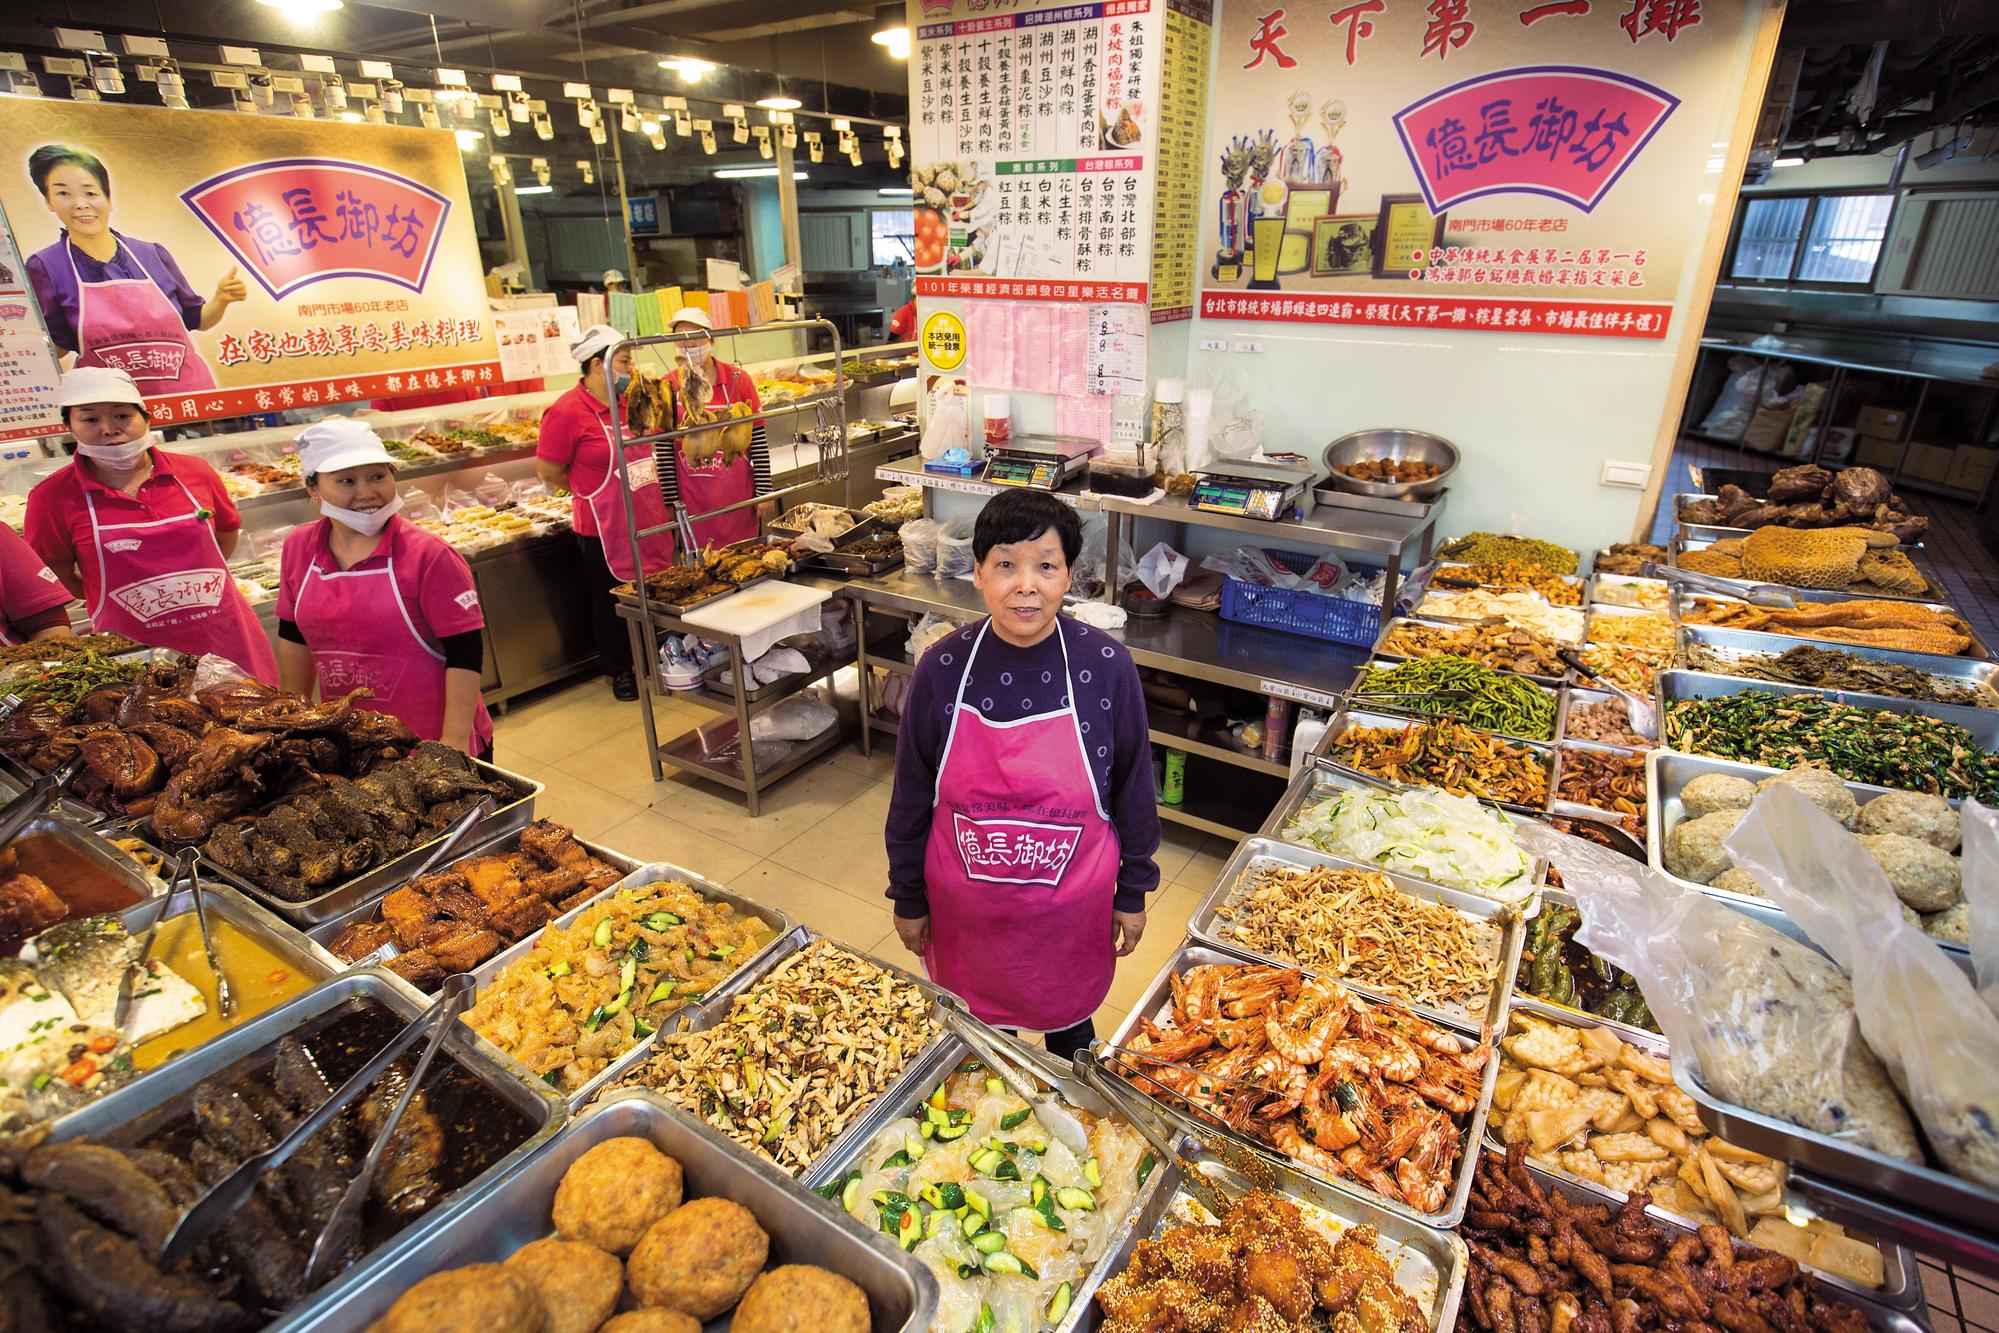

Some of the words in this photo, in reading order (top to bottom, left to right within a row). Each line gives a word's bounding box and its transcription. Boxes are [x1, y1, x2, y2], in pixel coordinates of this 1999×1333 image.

[921, 45, 935, 125] 紫米豆沙粽
[939, 43, 954, 124] 紫米鮮肉粽
[1038, 32, 1053, 117] 湖州豆沙粽
[1059, 29, 1075, 115] 湖州鮮肉粽
[1080, 26, 1098, 148] 湖州香菇蛋黃肉粽
[1426, 96, 1629, 180] 億長御坊
[233, 188, 424, 265] 億長御坊
[999, 180, 1012, 225] 紅豆粽
[1018, 180, 1032, 225] 紅棗粽
[1037, 179, 1052, 225] 白米粽
[1057, 178, 1072, 240] 花生素粽
[1076, 177, 1093, 272] 台灣排骨酥粽
[1098, 176, 1115, 257] 台灣南部粽
[1119, 176, 1137, 257] 台灣北部粽
[1448, 219, 1568, 233] 南門市場60年老店
[1429, 249, 1647, 266] 中華傳統美食展第二屆第一名
[297, 298, 408, 318] 南門市場60年老店
[923, 282, 1139, 301] 101年榮獲經濟部頒發四星樂活名攤
[218, 318, 480, 365] 在家也該享受美味料理
[928, 332, 960, 342] 本店免用
[928, 341, 960, 351] 統一發票
[960, 828, 1071, 871] 億長御坊
